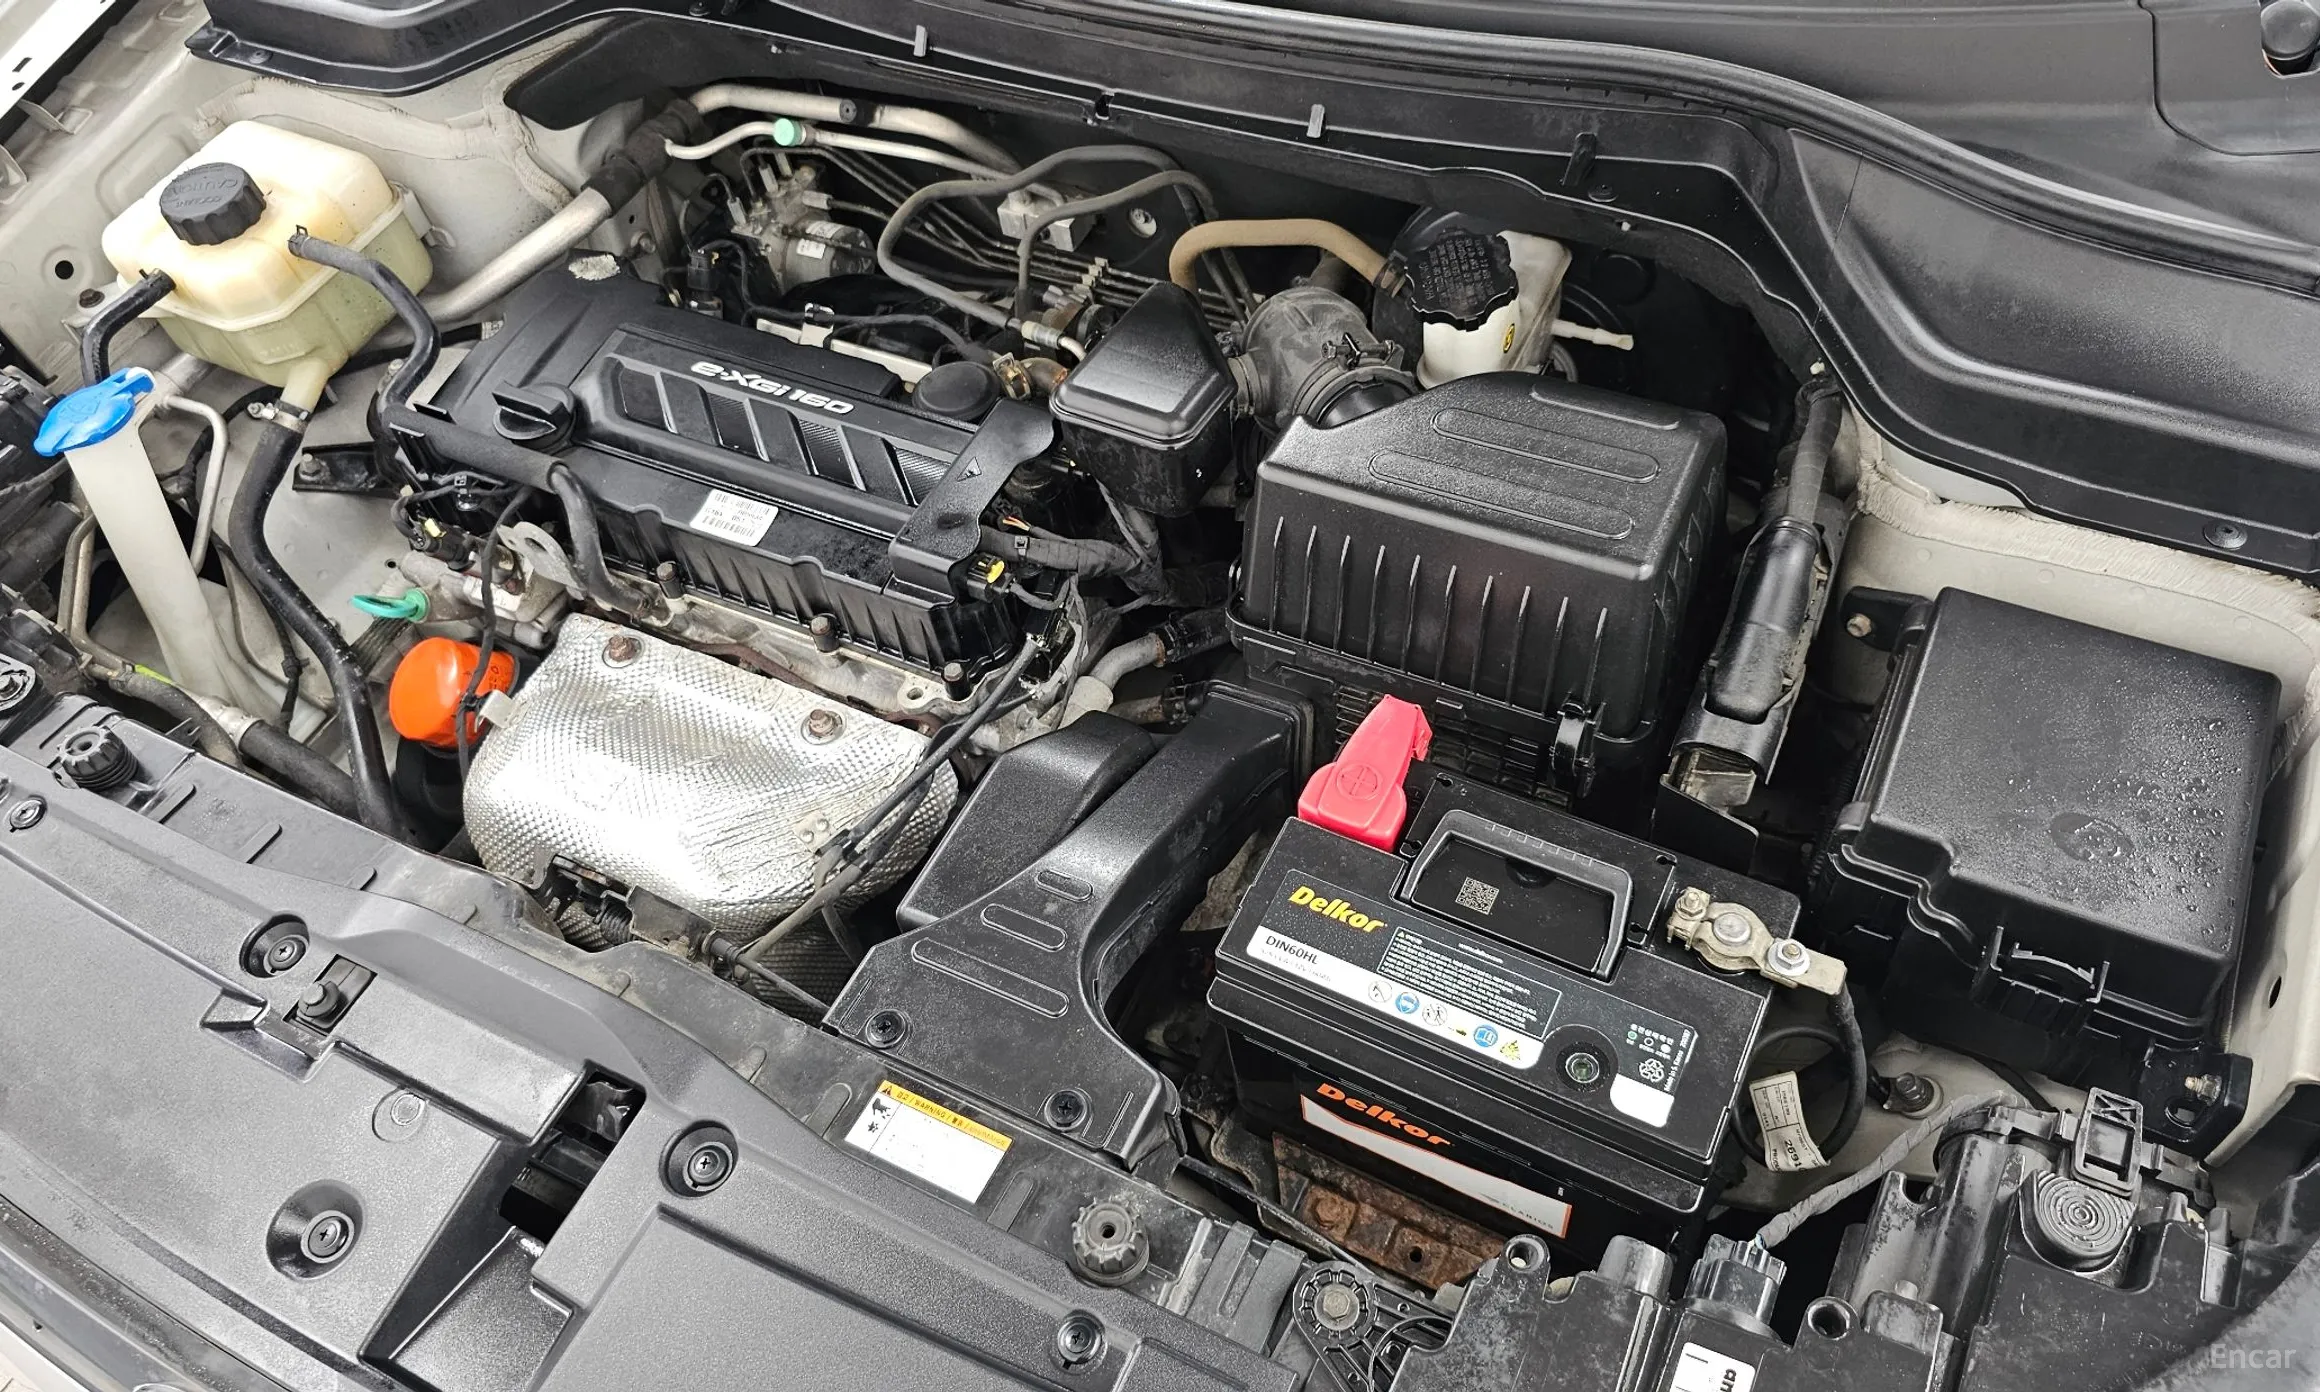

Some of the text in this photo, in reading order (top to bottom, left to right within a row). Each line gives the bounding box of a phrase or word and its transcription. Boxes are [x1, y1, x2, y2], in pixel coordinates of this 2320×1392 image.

[1288, 885, 1385, 933] Delkor
[1265, 935, 1319, 965] DIN60HL
[1316, 1082, 1452, 1146] Delkor
